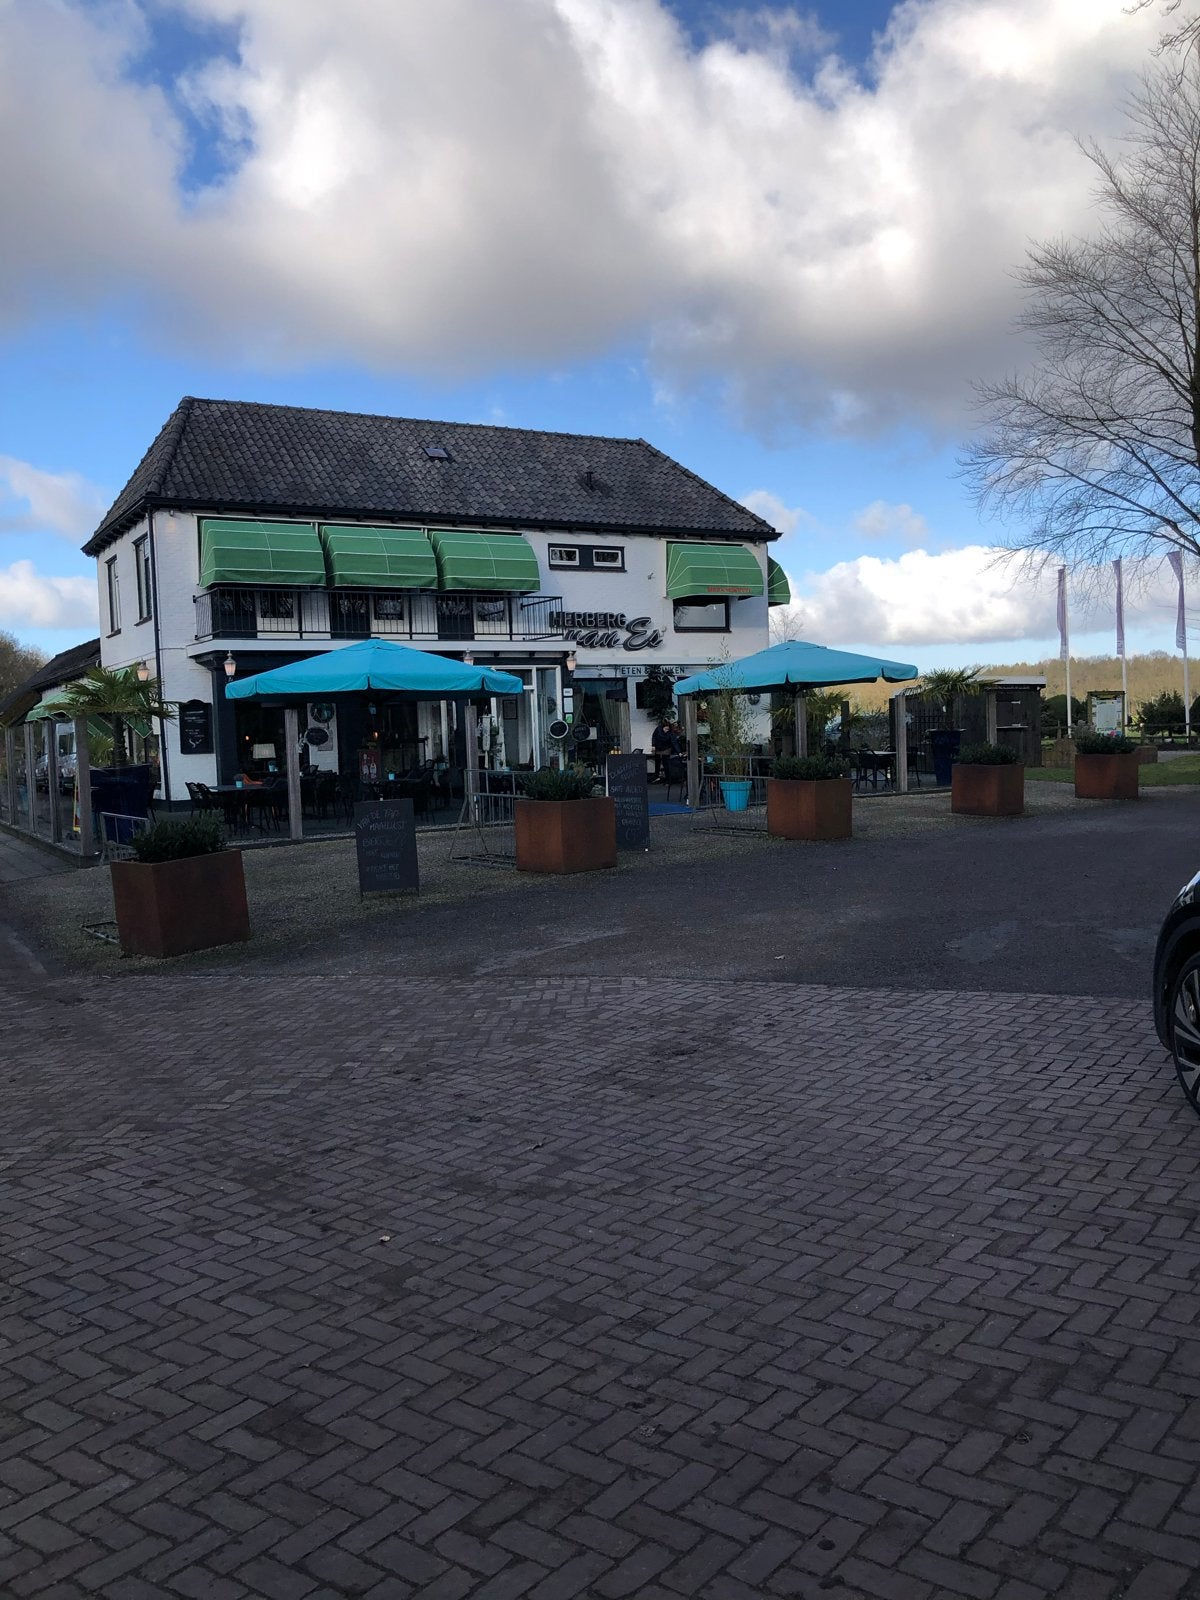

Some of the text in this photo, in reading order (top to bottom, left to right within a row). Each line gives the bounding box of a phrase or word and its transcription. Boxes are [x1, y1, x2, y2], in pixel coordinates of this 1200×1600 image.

[549, 611, 627, 628] HERBERG
[564, 617, 663, 651] van Es
[621, 666, 642, 675] ETEN
